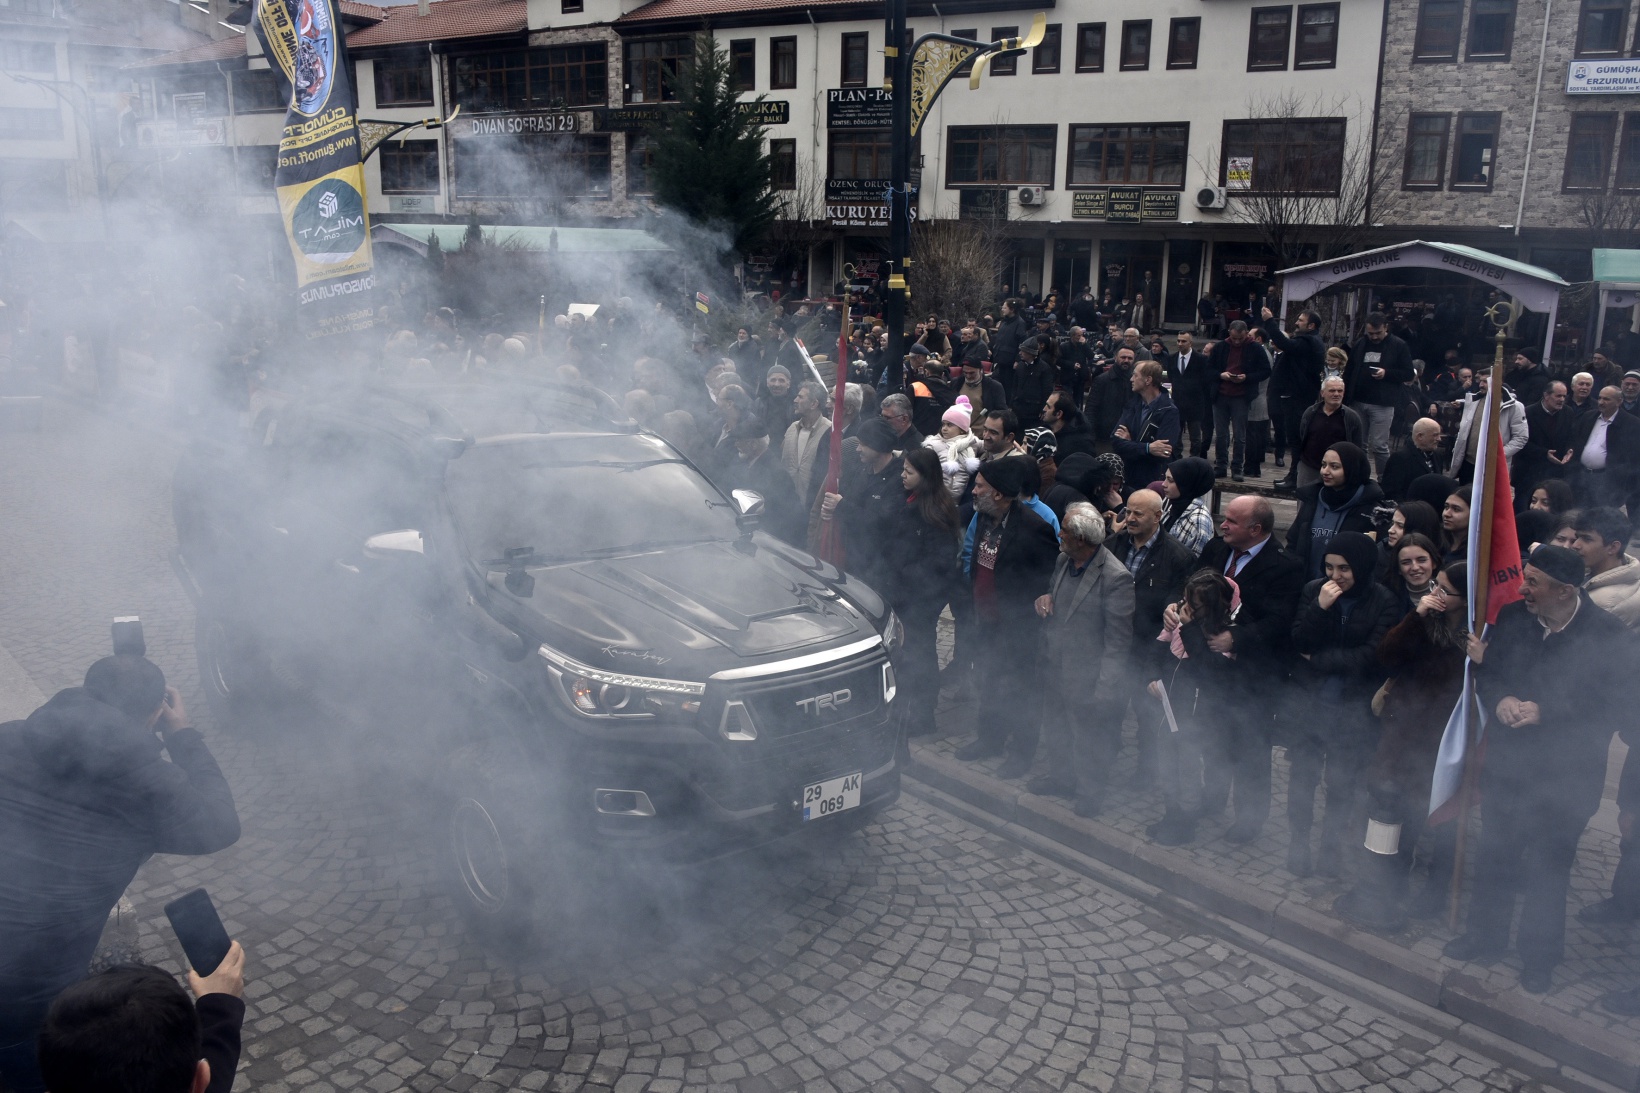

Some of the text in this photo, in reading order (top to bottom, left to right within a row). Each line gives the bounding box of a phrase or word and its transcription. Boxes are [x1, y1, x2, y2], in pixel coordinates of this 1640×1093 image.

[1586, 77, 1640, 85] ERZURUML
[558, 115, 574, 131] 29
[795, 688, 852, 716] TRD
[805, 774, 860, 803] 29 AK
[820, 795, 844, 815] 069
